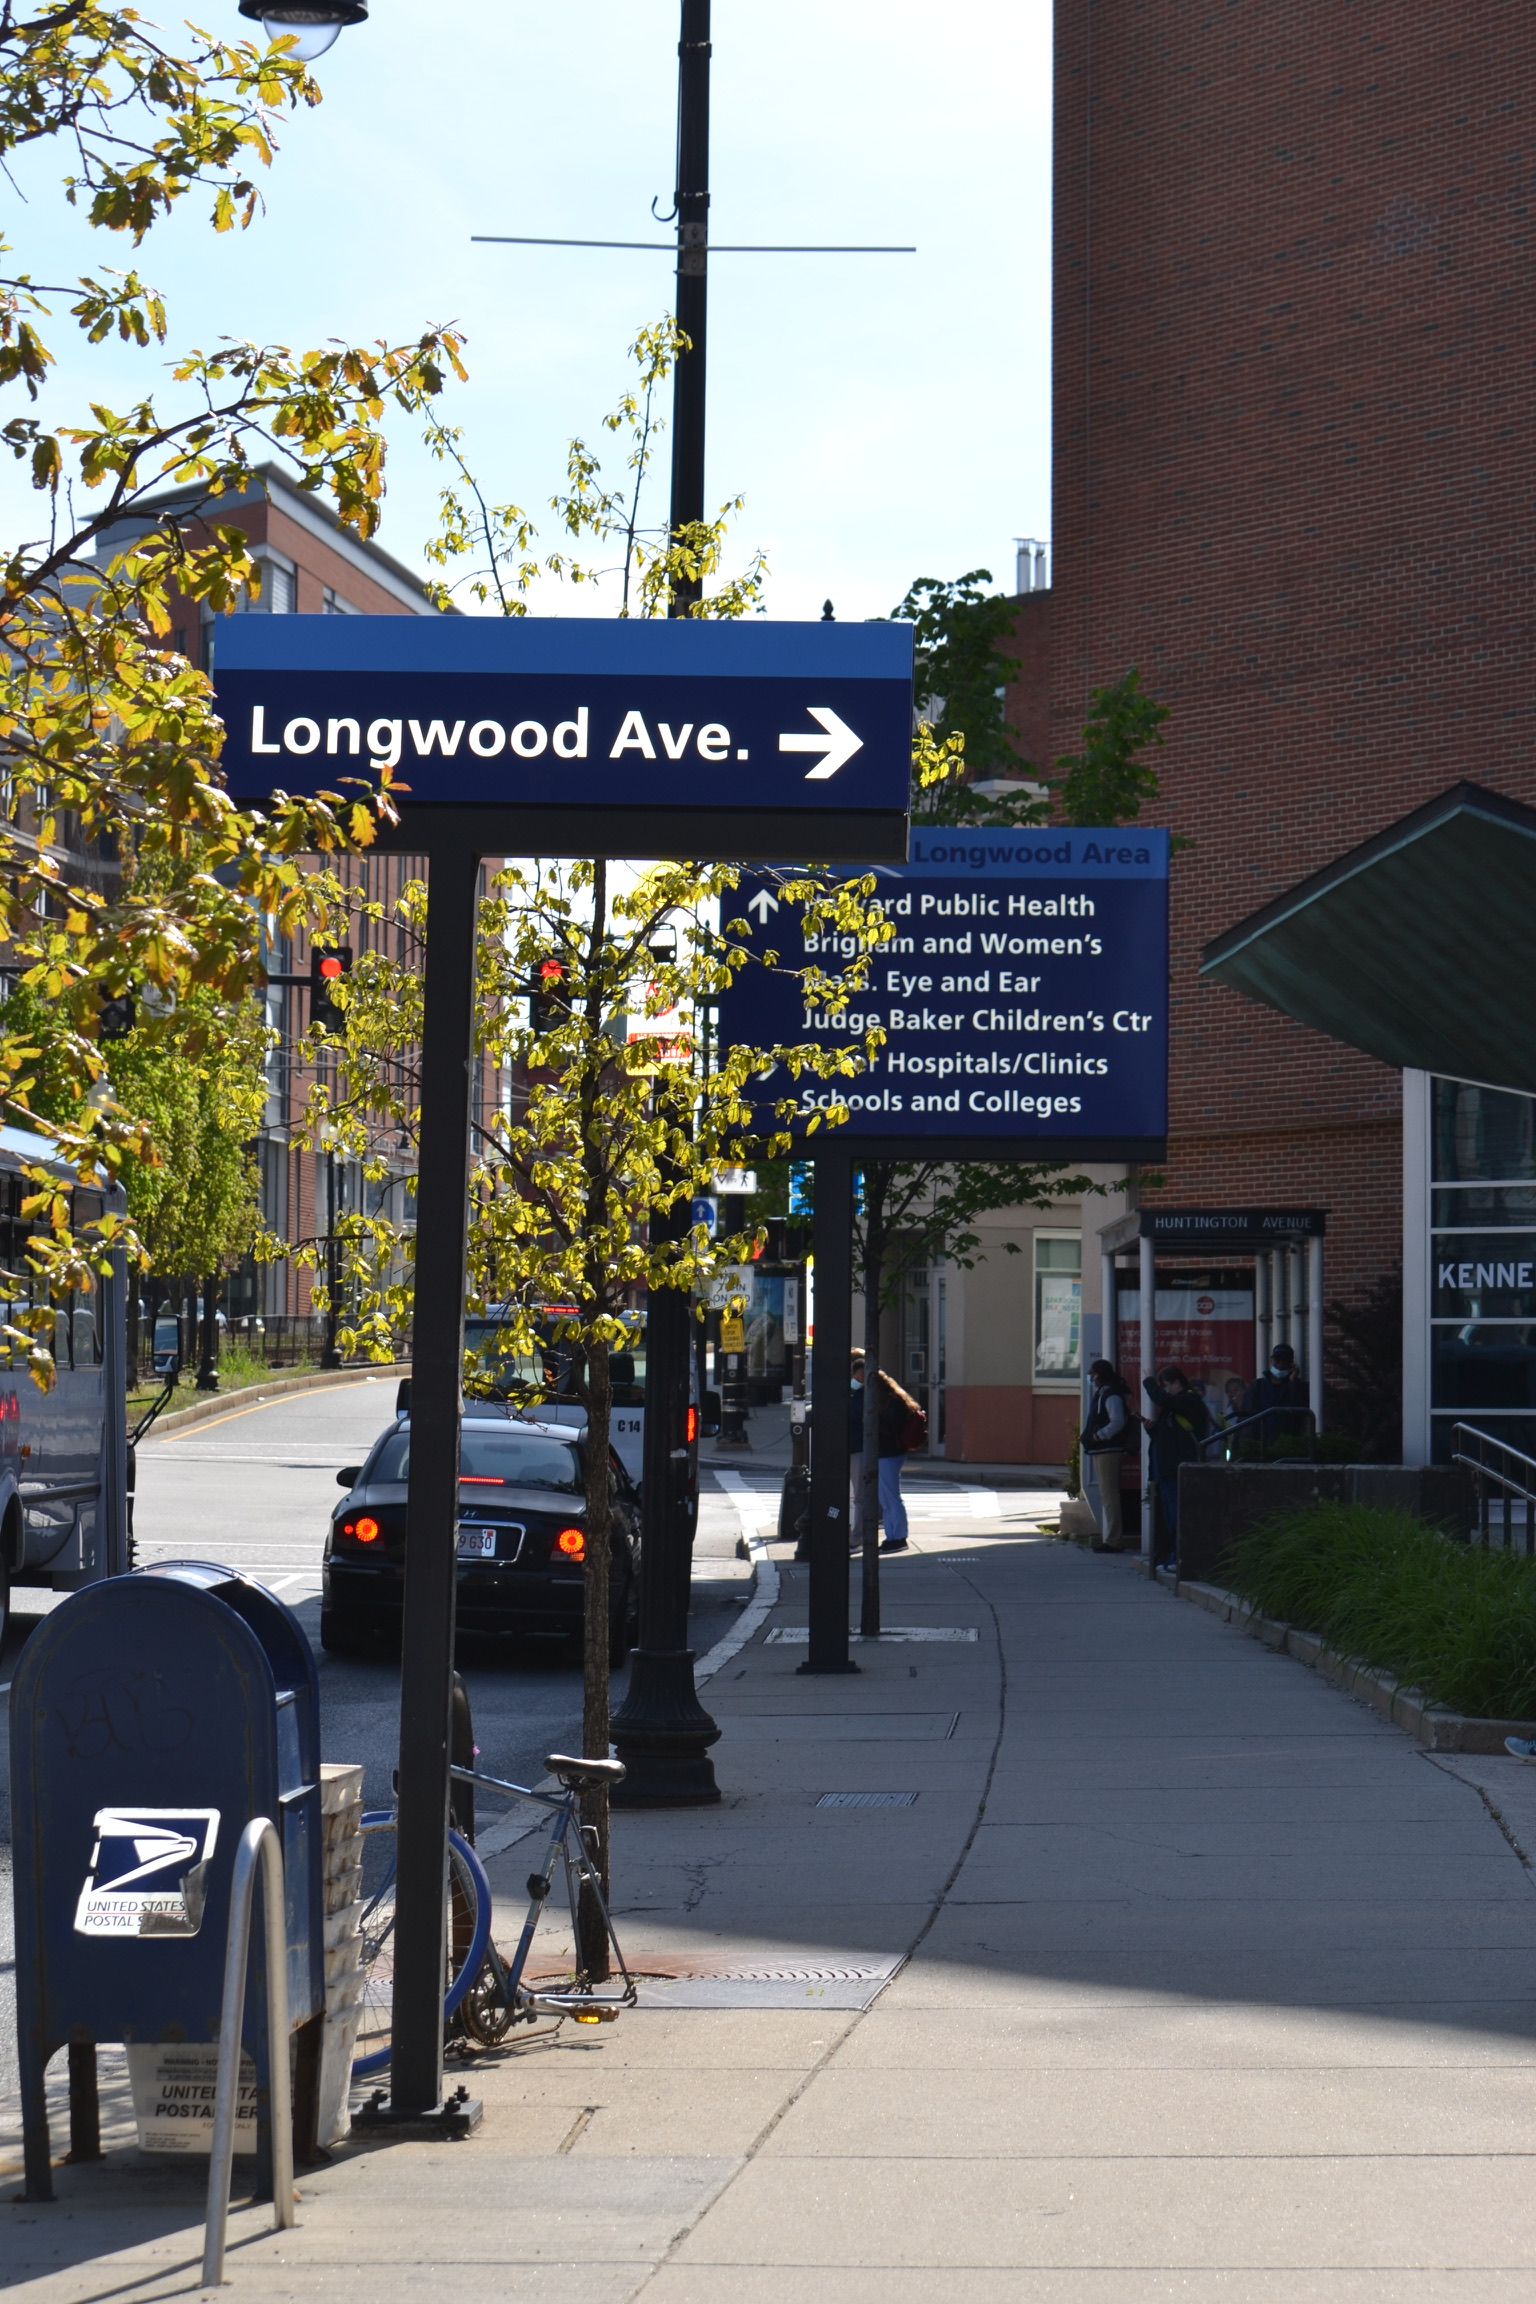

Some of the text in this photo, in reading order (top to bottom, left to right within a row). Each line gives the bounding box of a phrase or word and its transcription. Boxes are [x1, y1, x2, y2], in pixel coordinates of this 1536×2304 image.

[252, 706, 749, 769] Longwood Ave.
[914, 840, 1151, 869] Longwood Area
[920, 894, 1000, 916] Public
[1008, 894, 1095, 917] Health
[923, 932, 972, 954] and
[980, 933, 1103, 955] Women's
[887, 971, 932, 998] Eye
[940, 970, 990, 993] and
[999, 972, 1041, 993] Ear
[801, 1008, 1152, 1035] Judge Baker Children's Ctr
[887, 1051, 1109, 1079] Hospitals/Clinics
[801, 1088, 1082, 1119] Schools and Colleges
[1155, 1216, 1312, 1229] HUNTINGTON AVENUE
[1438, 1262, 1534, 1289] KENNE
[713, 1294, 728, 1302] ON
[617, 1419, 641, 1433] C 14
[469, 1535, 492, 1550] G30
[87, 1901, 186, 1912] UNITED STATES
[84, 1915, 134, 1926] POSTAL
[164, 2058, 200, 2066] WARNING
[155, 2103, 215, 2118] POSTA
